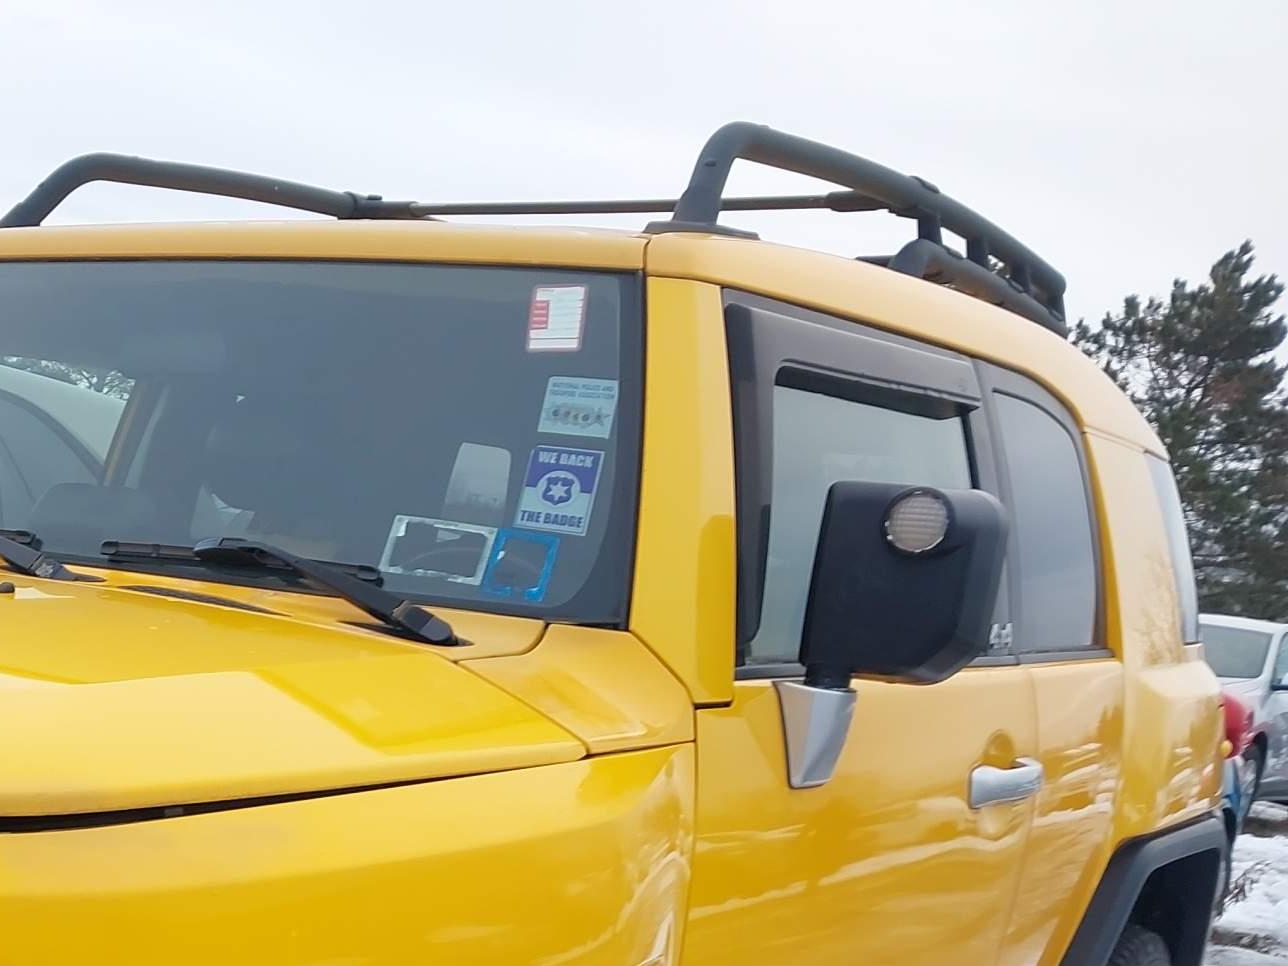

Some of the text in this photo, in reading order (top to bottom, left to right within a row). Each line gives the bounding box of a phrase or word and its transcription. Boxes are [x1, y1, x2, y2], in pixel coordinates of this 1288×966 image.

[538, 451, 594, 468] WE BACK
[520, 510, 584, 528] THE BADGE
